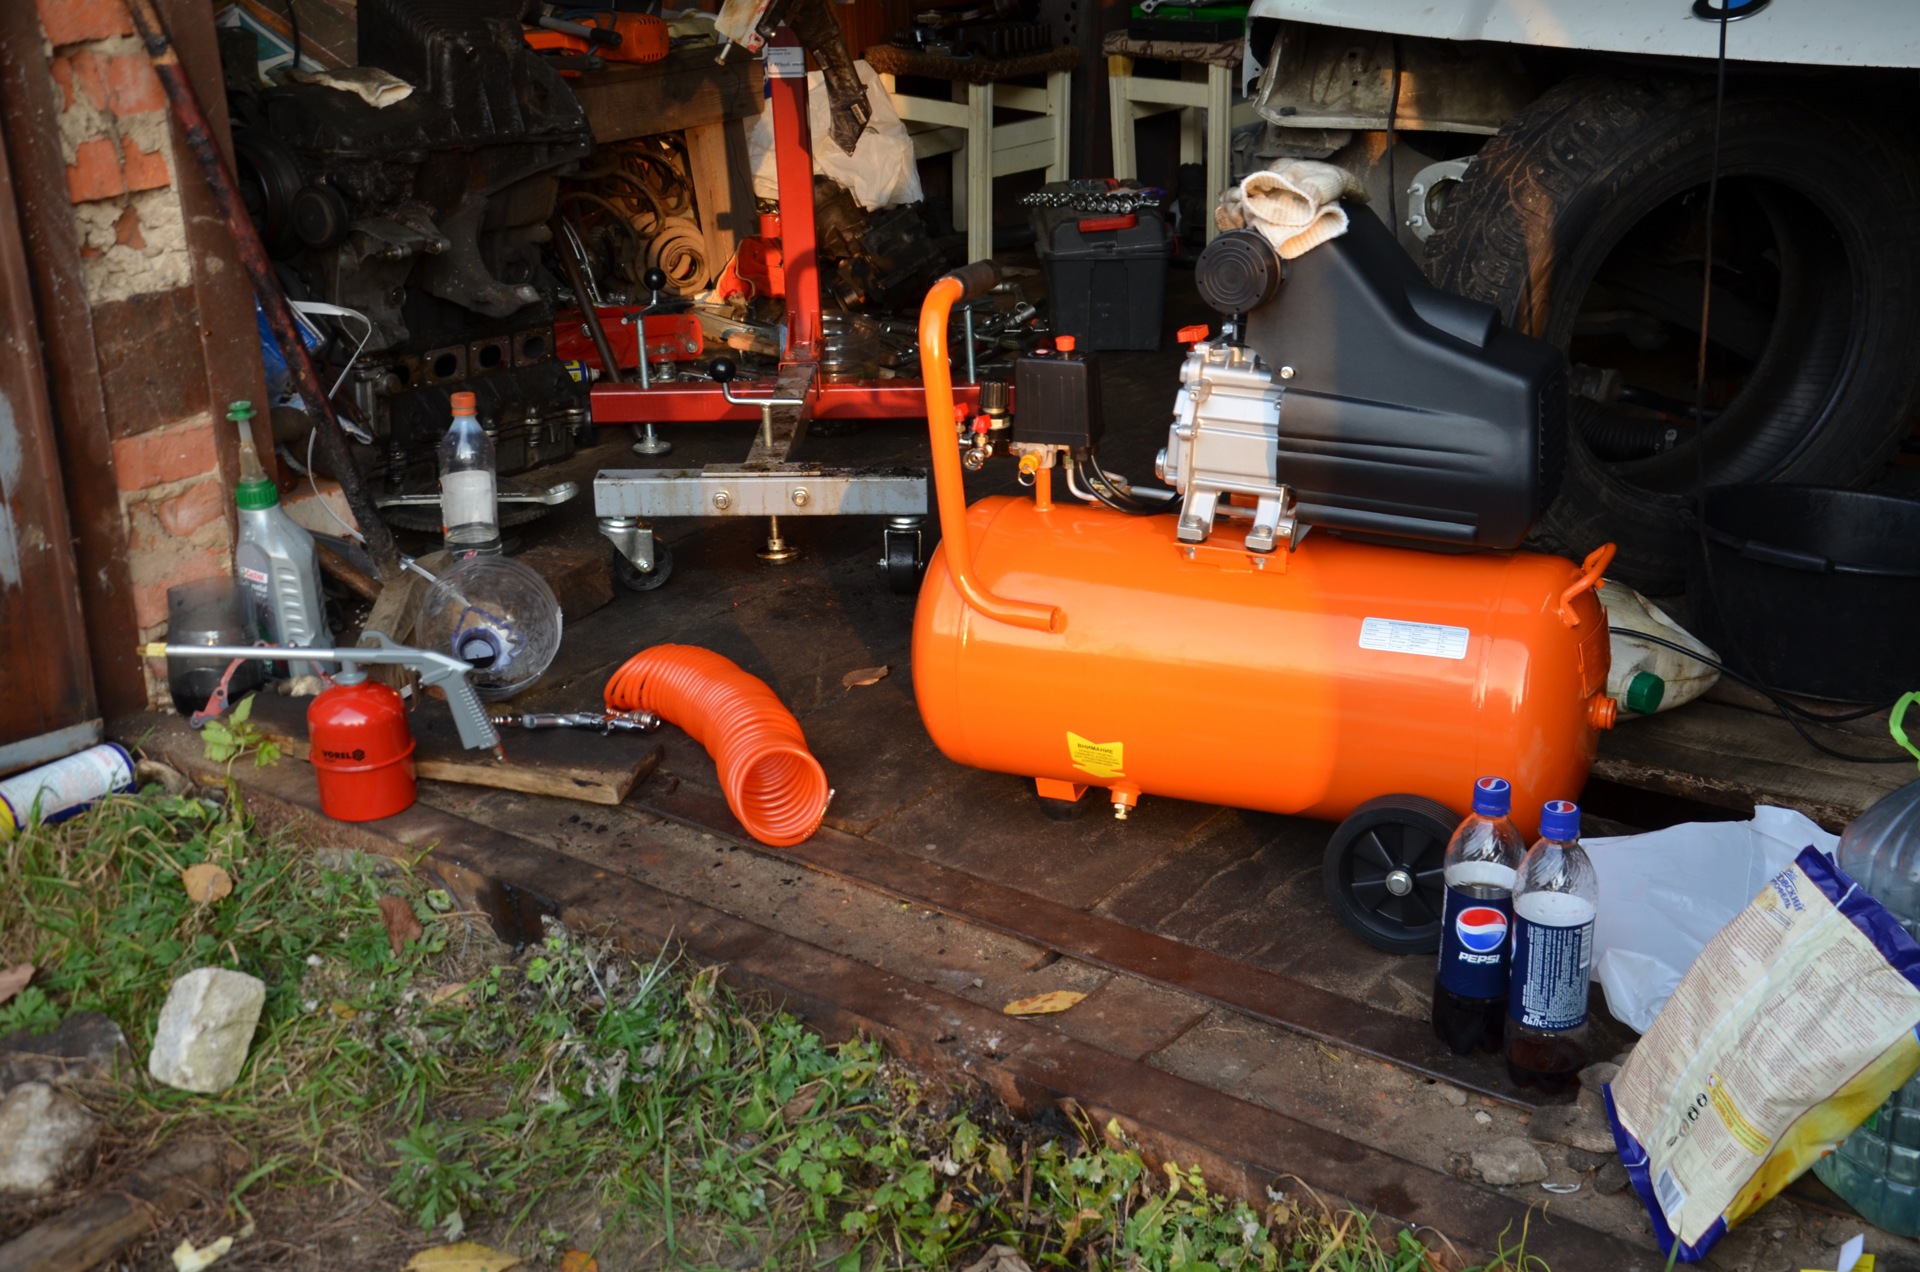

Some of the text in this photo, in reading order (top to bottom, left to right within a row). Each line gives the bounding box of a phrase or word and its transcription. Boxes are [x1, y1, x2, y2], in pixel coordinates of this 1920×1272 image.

[1077, 744, 1114, 754] ВНИМАНИЕ
[322, 750, 352, 759] VOREL
[1458, 952, 1501, 964] PEPSI
